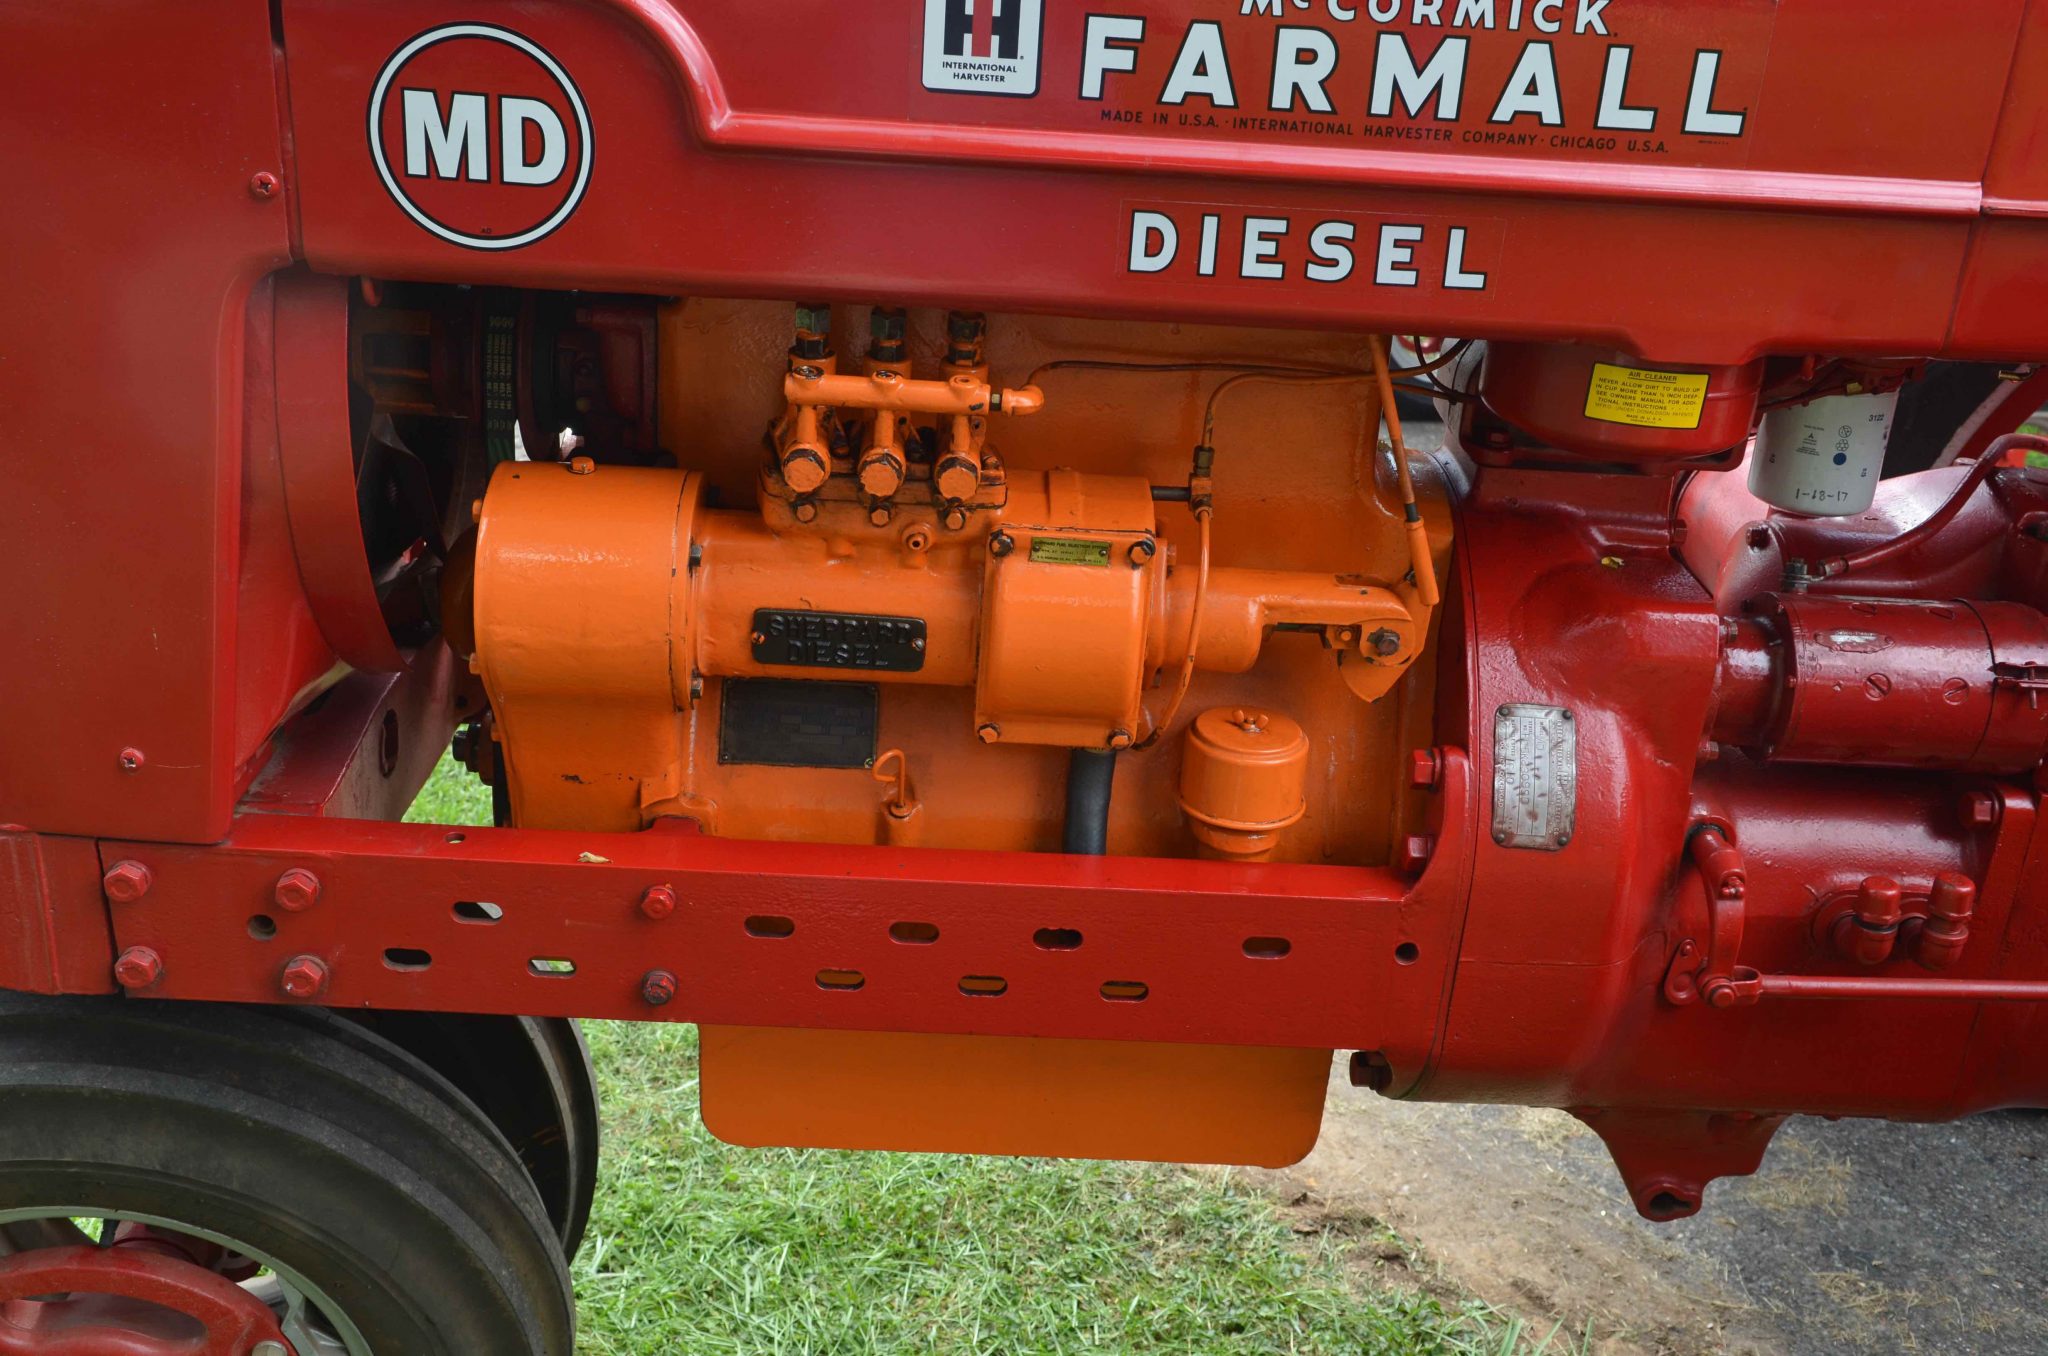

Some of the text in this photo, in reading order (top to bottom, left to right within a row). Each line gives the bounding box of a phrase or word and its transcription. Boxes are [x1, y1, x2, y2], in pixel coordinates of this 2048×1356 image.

[942, 61, 1017, 73] INTERNATIONAL
[953, 72, 1006, 82] HARVESTER
[1080, 14, 1745, 138] FARMALL
[1101, 109, 1669, 153] MADE IN U.S.A. INTERNATIONAL HARVESTER COMPANY CHICAGO U.S.A.
[401, 87, 569, 187] MD
[1128, 208, 1487, 290] DIESEL
[1599, 377, 1619, 385] NEVER
[1644, 373, 1678, 381] CLEANER
[1620, 387, 1638, 395] MORE
[1640, 397, 1666, 405] MANUAL
